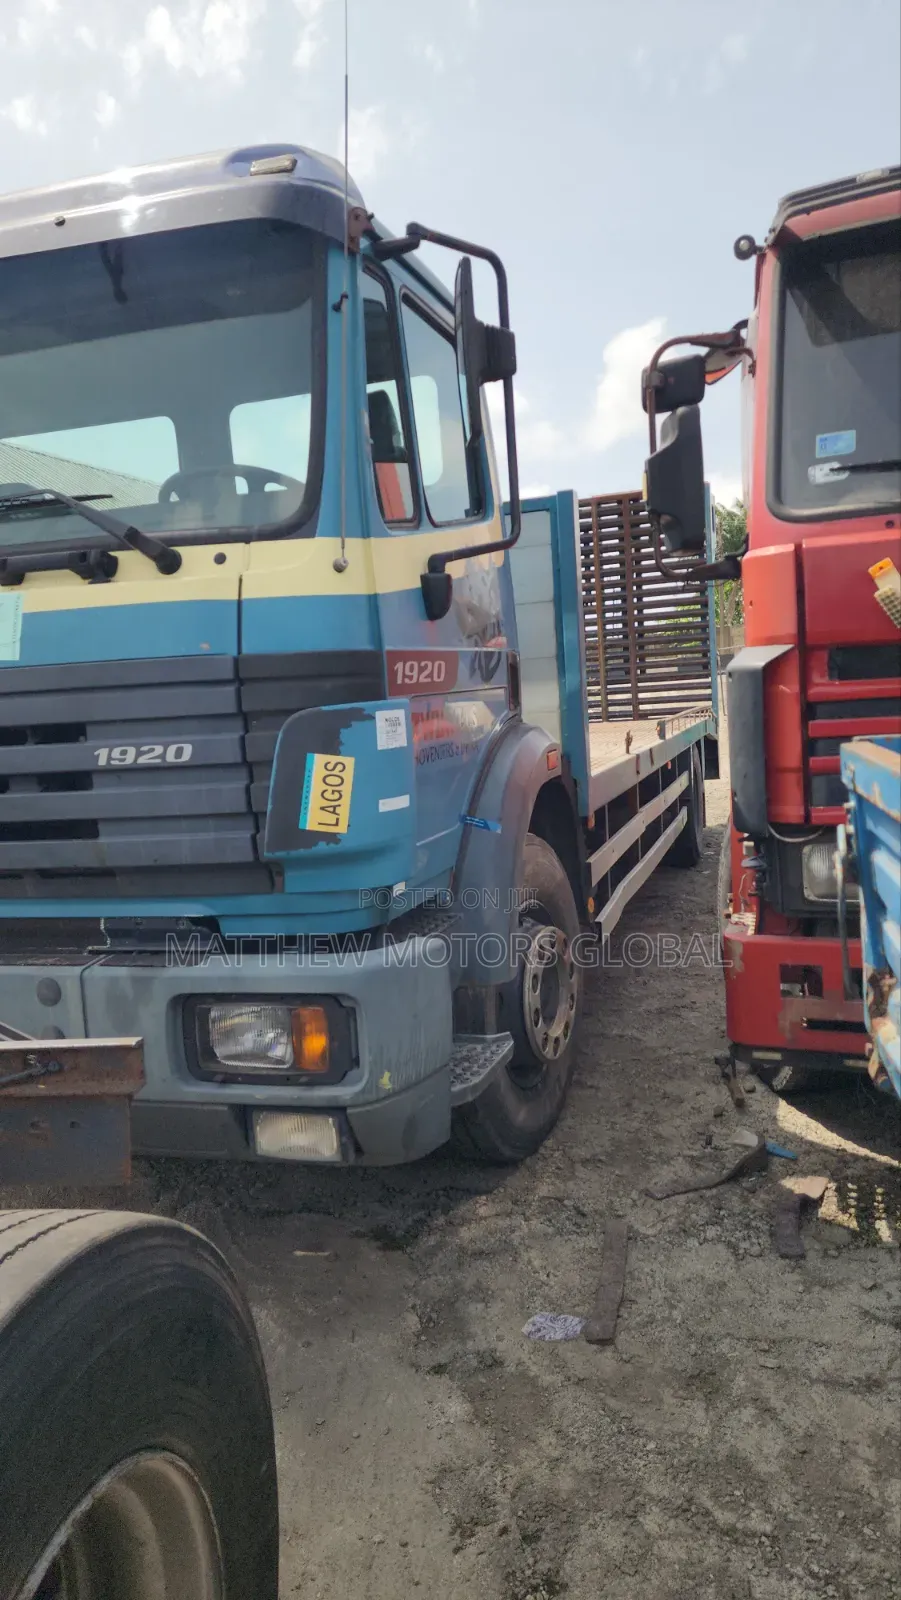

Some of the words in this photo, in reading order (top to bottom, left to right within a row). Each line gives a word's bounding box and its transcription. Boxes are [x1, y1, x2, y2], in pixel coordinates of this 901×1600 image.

[394, 660, 446, 685] 1920
[93, 743, 193, 766] 1920
[317, 761, 346, 827] LAGOS
